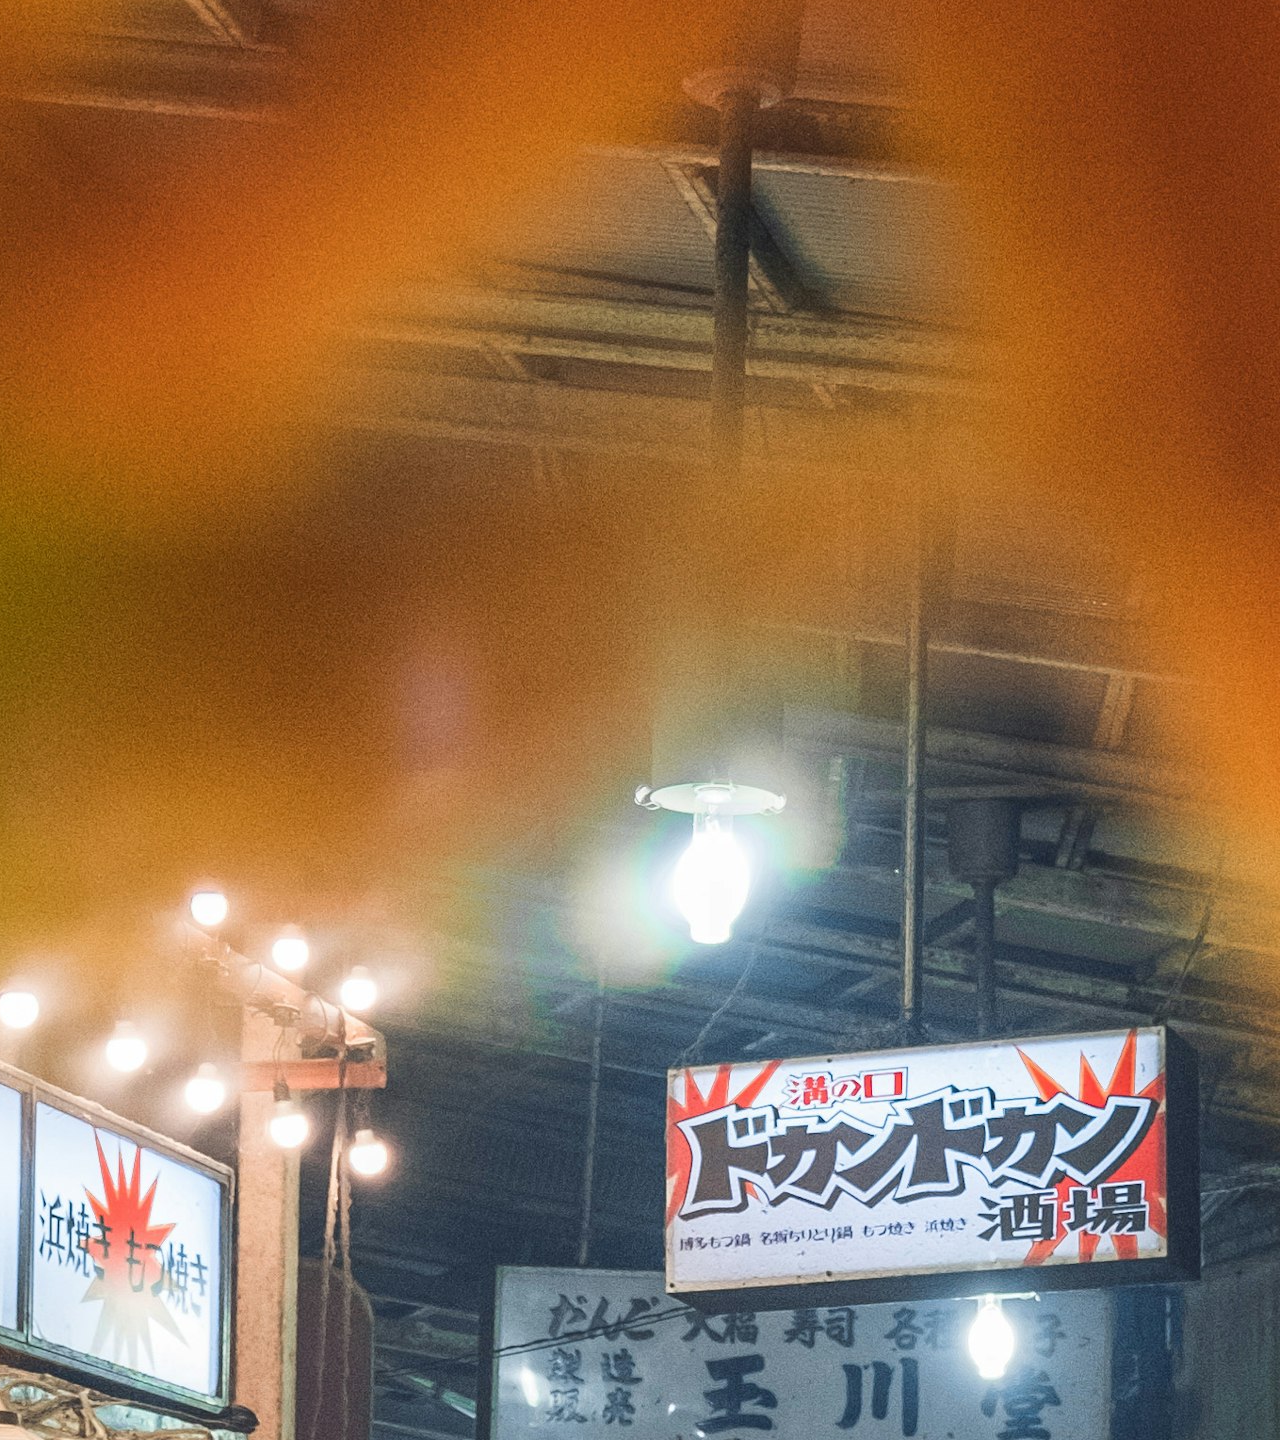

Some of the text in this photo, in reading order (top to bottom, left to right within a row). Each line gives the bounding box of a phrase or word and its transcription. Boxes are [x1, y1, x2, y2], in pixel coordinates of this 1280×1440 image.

[789, 1070, 905, 1106] 溝の口
[682, 1088, 1156, 1216] ドカンドカン
[679, 1234, 752, 1252] 博多もつ鍋
[863, 1221, 915, 1237] もつ焼き
[925, 1218, 968, 1234] 浜焼き
[977, 1182, 1147, 1242] 酒場
[38, 1189, 208, 1317] 浜焼き もつ焼き
[784, 1308, 858, 1348] 寿司
